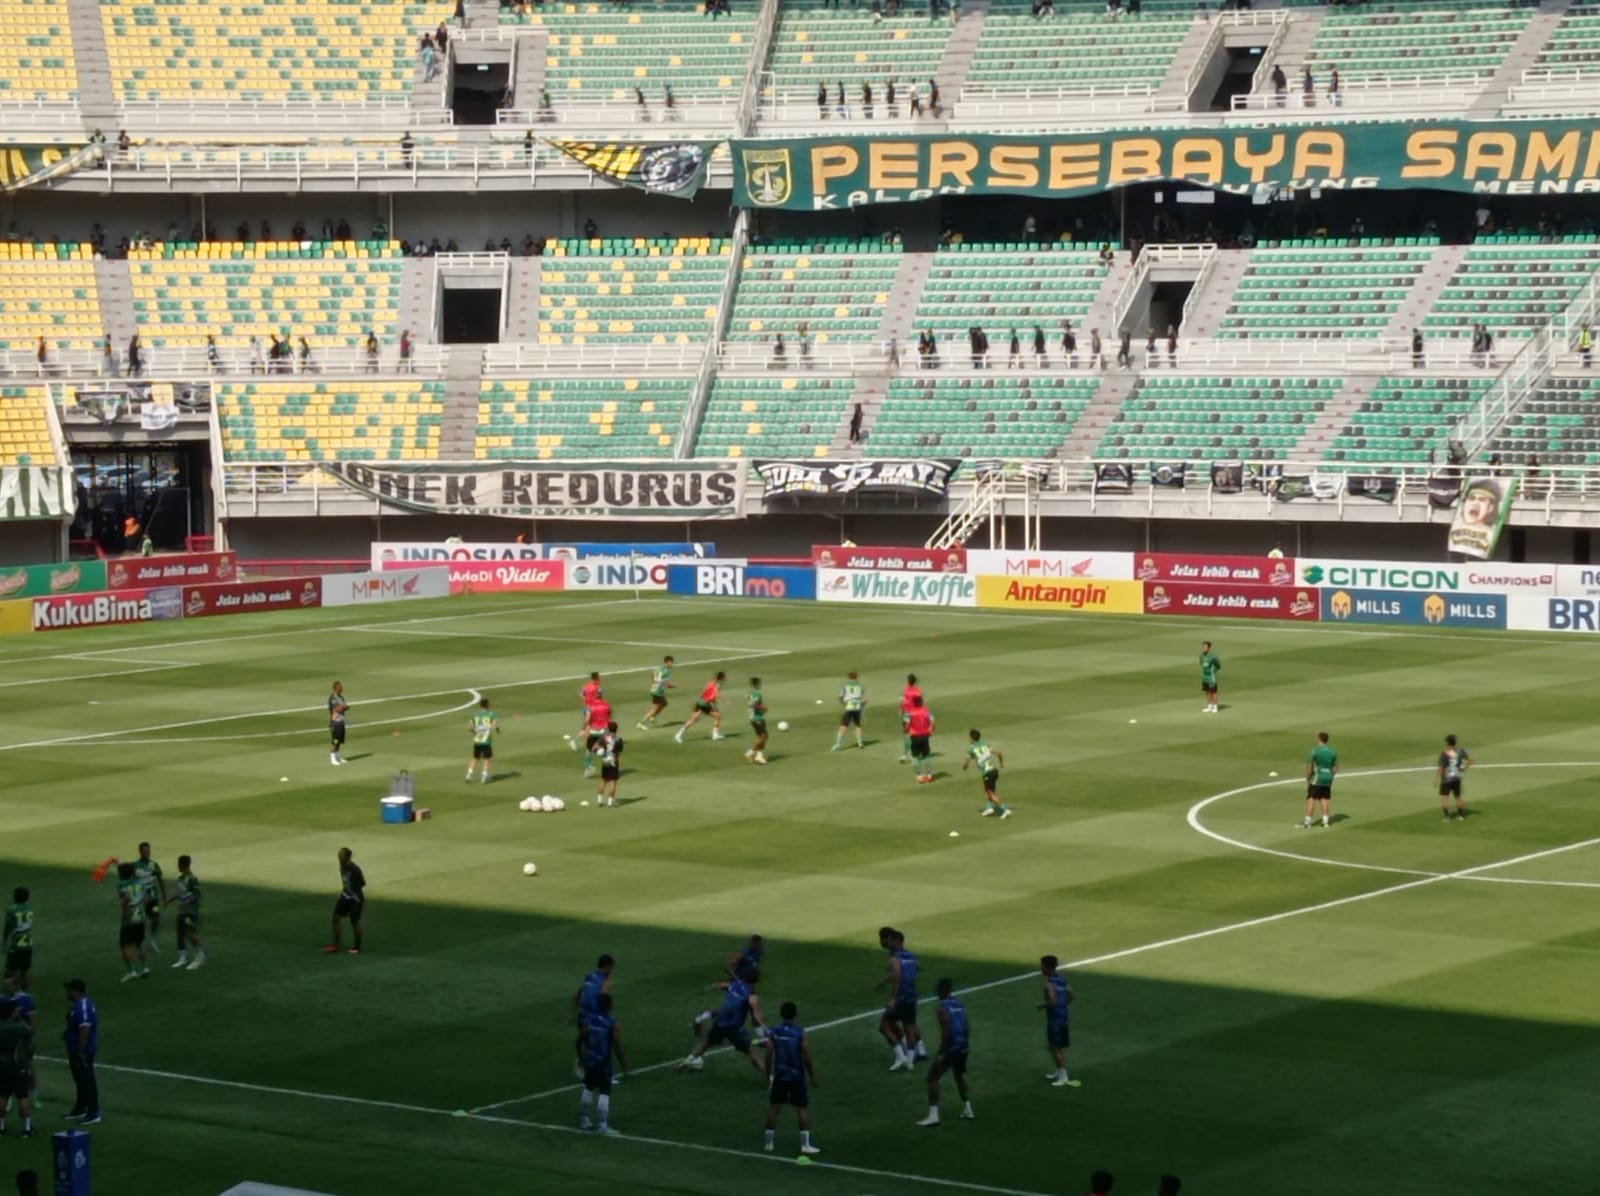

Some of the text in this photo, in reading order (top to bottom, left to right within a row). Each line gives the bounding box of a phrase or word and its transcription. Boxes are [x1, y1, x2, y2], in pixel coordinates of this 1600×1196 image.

[811, 131, 1345, 195] PERSEBAYA
[502, 471, 736, 507] KEDURUS
[847, 556, 874, 569] Jelas
[877, 557, 904, 569] lebih
[1006, 559, 1062, 577] MPM
[1170, 564, 1199, 577] Jelas
[1201, 565, 1230, 578] lebih
[1232, 567, 1260, 579] enak
[448, 566, 551, 585] AdaDi Vidio
[1329, 567, 1459, 590] CITICON
[352, 578, 397, 600] MPM
[851, 572, 910, 600] White
[911, 573, 975, 606] Koffie
[1004, 580, 1107, 609] Antangin
[34, 596, 153, 628] KukuBima
[1183, 594, 1214, 607] Jelas
[1217, 595, 1247, 608] lebih
[1250, 597, 1280, 609] enak
[1356, 600, 1401, 615] MILLS
[1450, 603, 1496, 618] MILLS
[1548, 598, 1600, 631] BR
